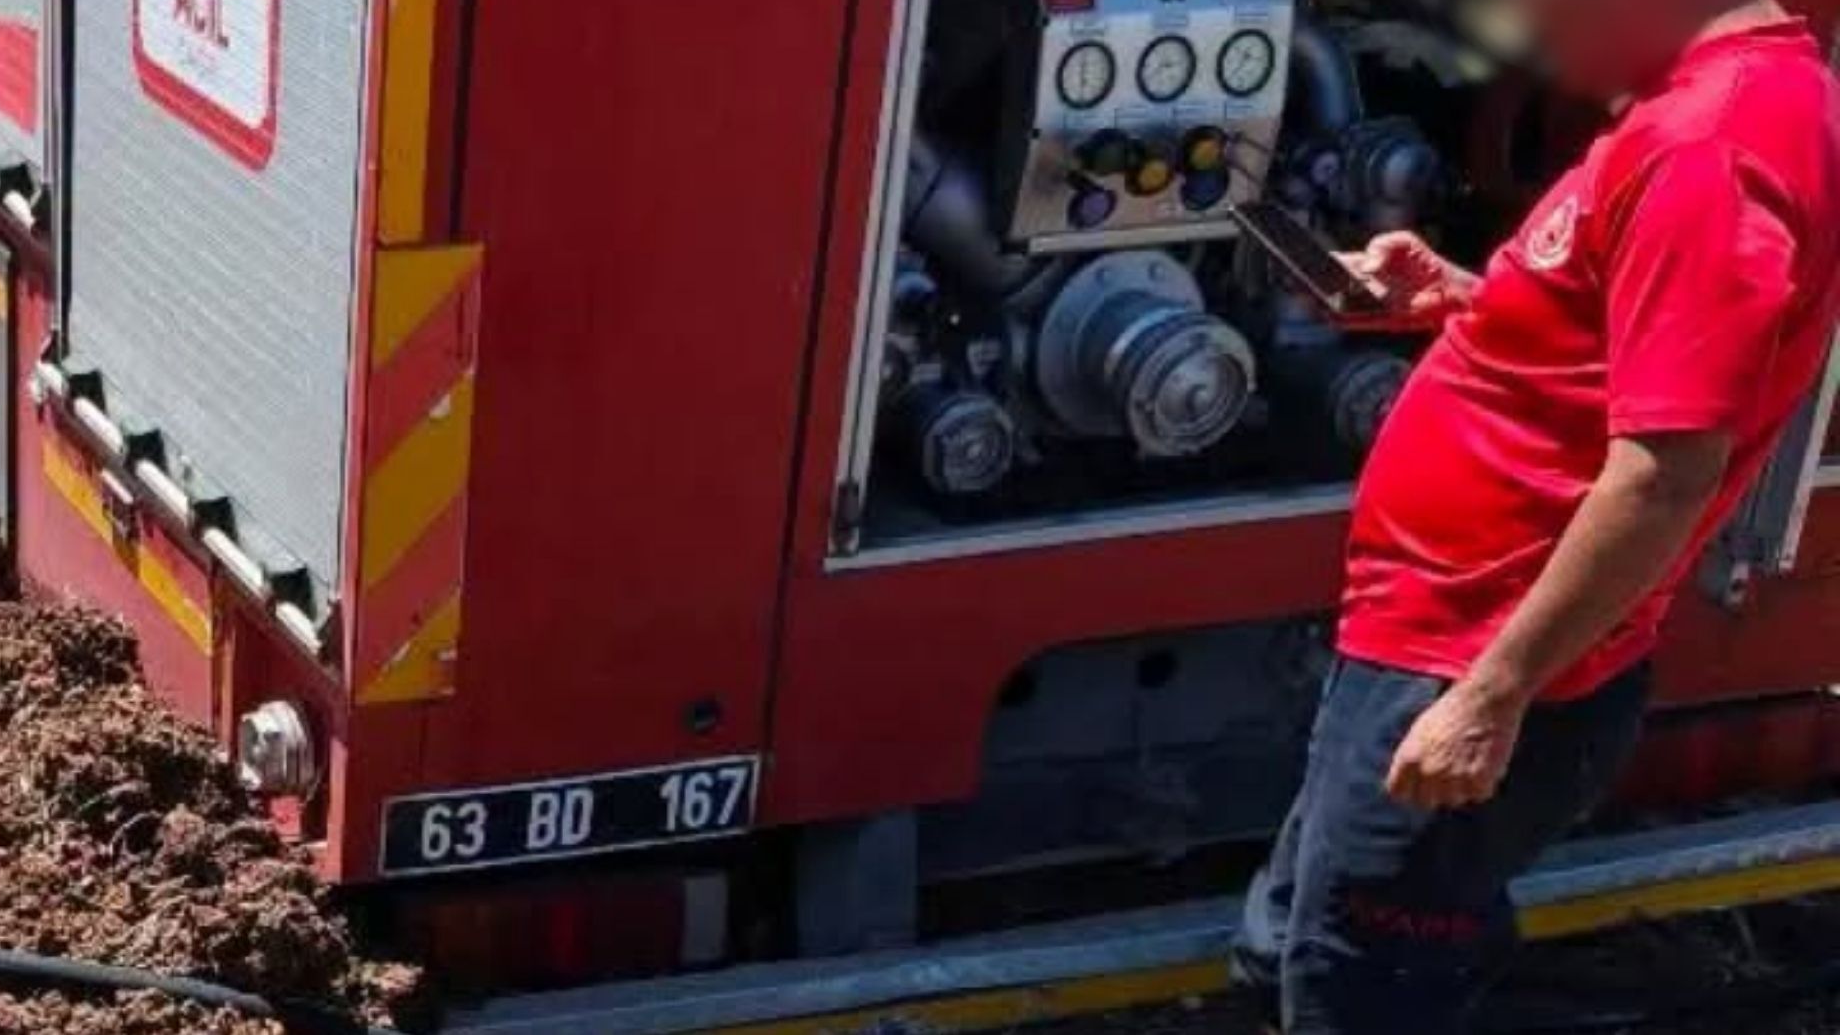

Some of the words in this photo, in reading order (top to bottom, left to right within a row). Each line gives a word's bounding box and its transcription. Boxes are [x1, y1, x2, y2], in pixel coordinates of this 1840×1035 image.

[421, 800, 488, 860] 63
[526, 787, 594, 849] BD
[660, 767, 747, 832] 167
